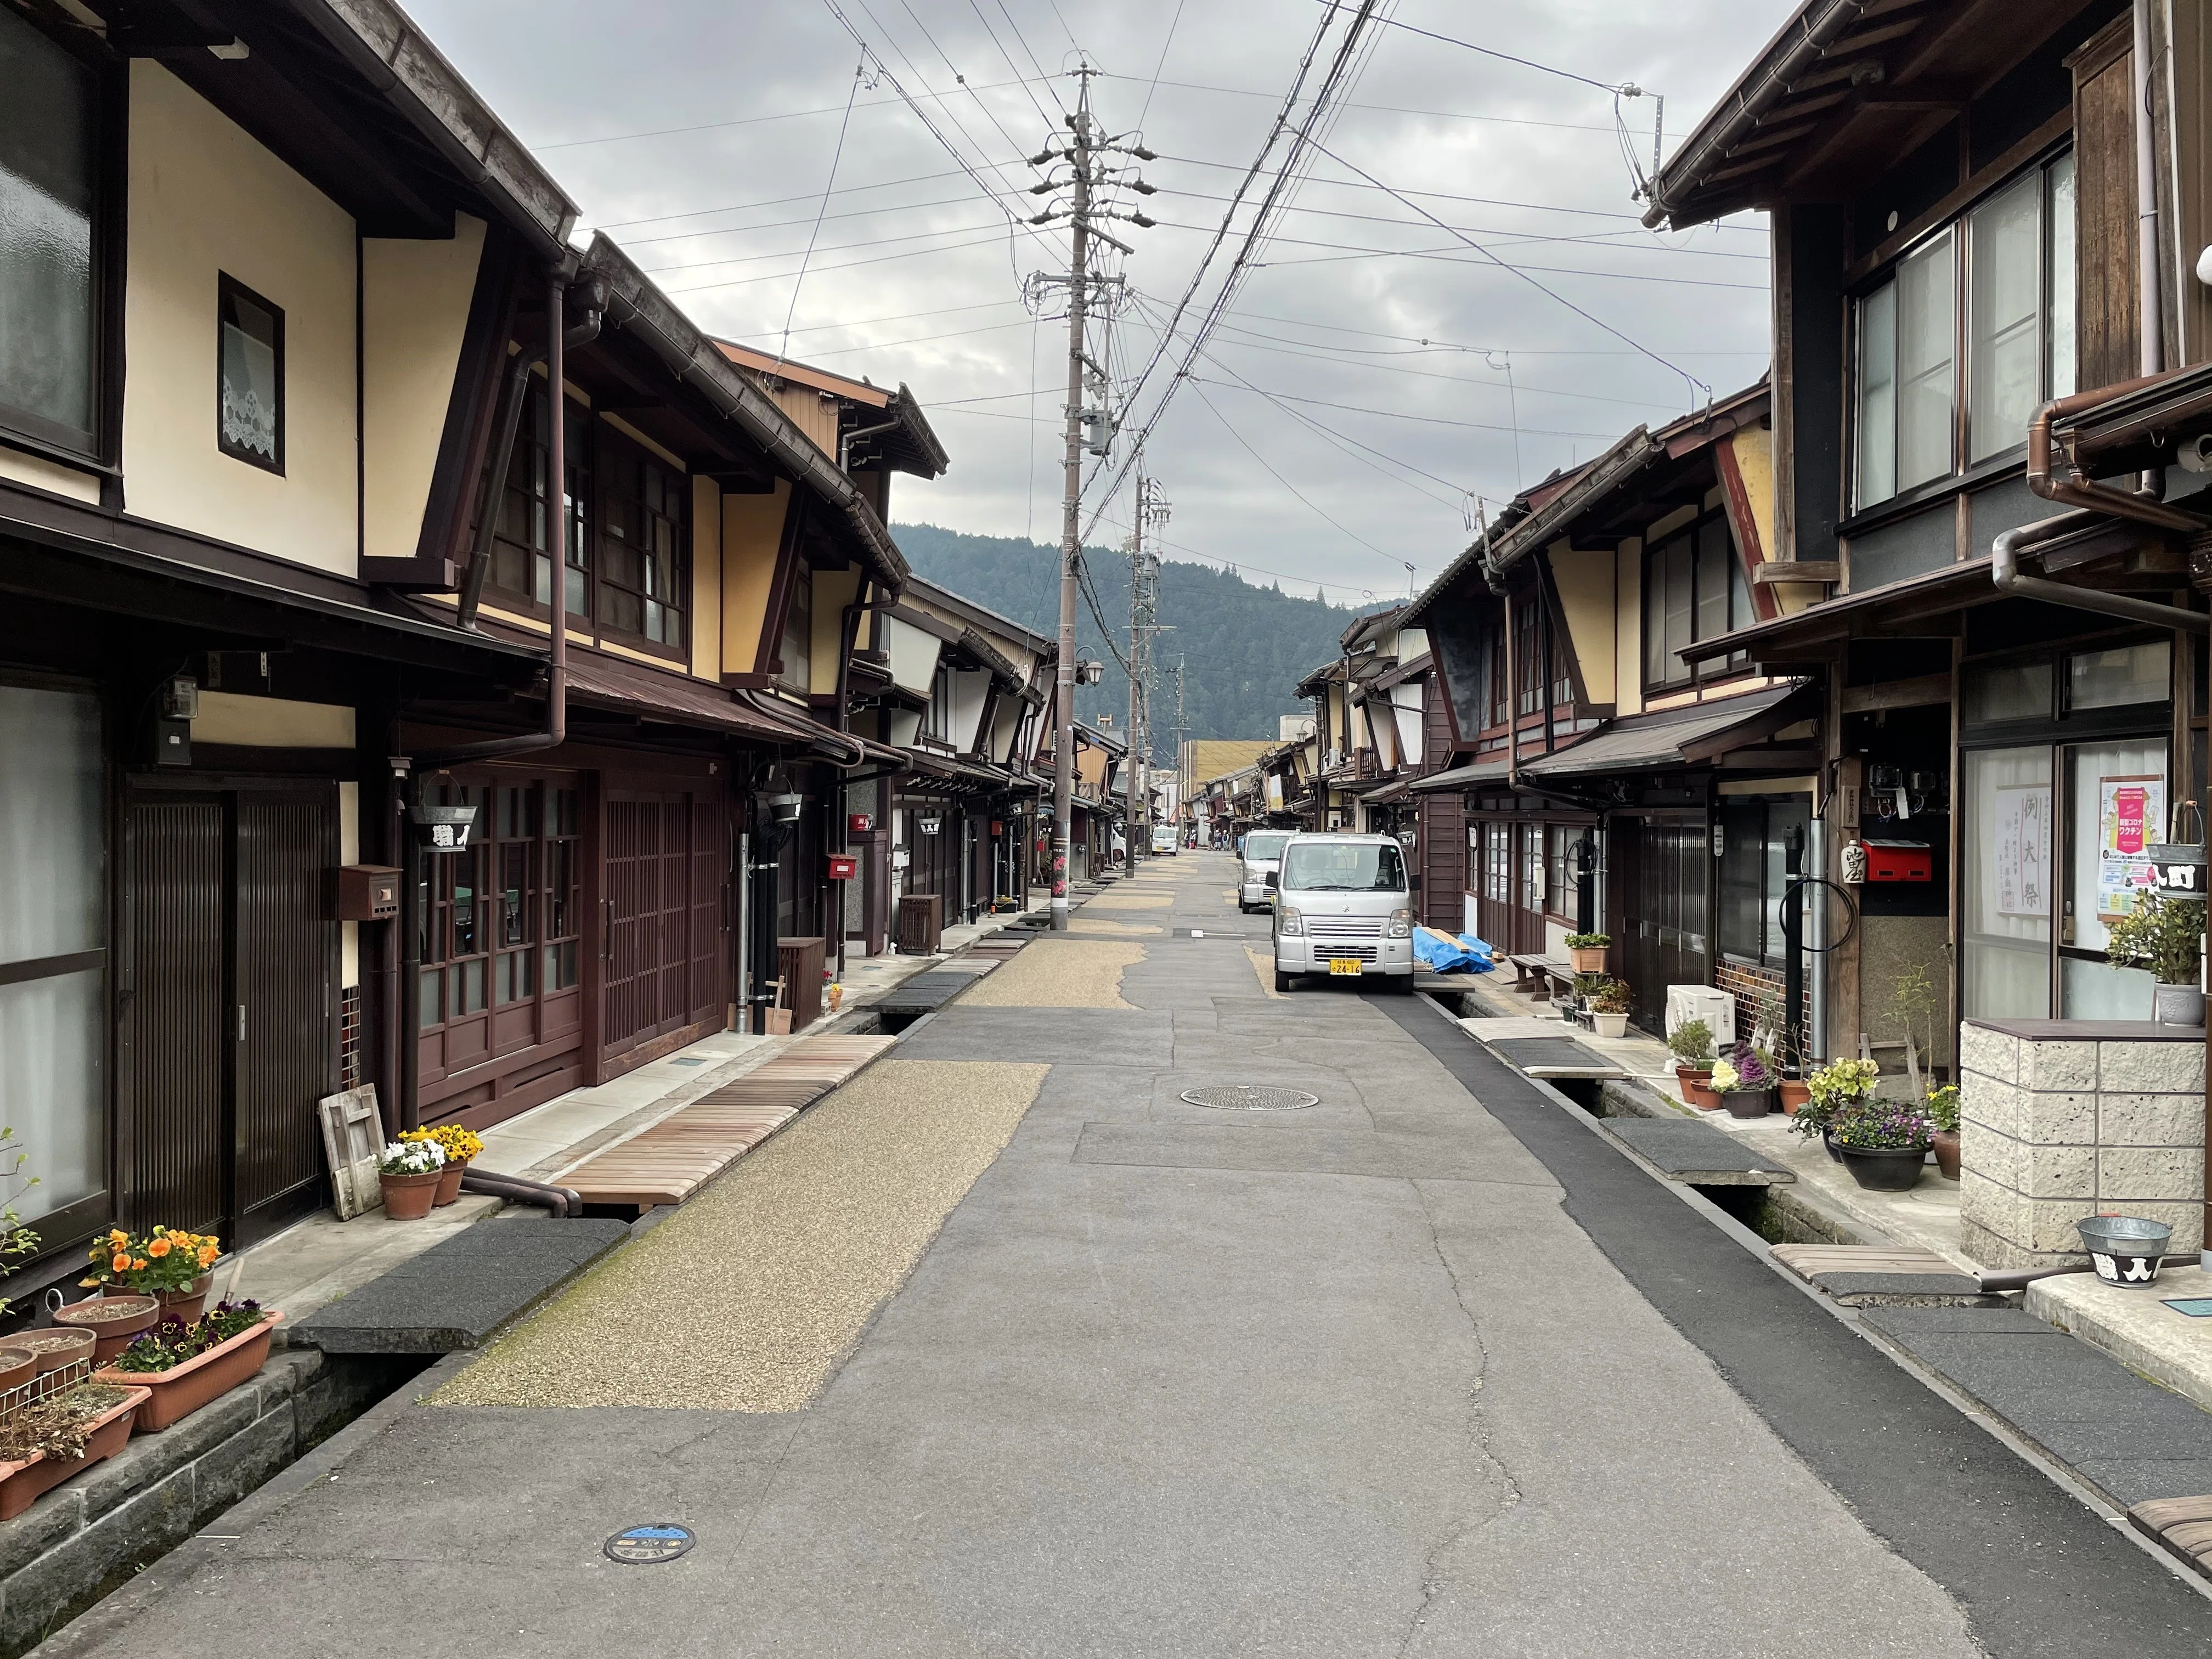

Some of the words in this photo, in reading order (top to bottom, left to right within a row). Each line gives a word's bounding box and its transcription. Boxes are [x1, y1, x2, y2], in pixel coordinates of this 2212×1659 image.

[2119, 818, 2143, 826] 新型コロナ
[2119, 827, 2142, 836] ワクチン
[2023, 795, 2039, 908] 例大祭
[1337, 965, 1359, 973] 24-16
